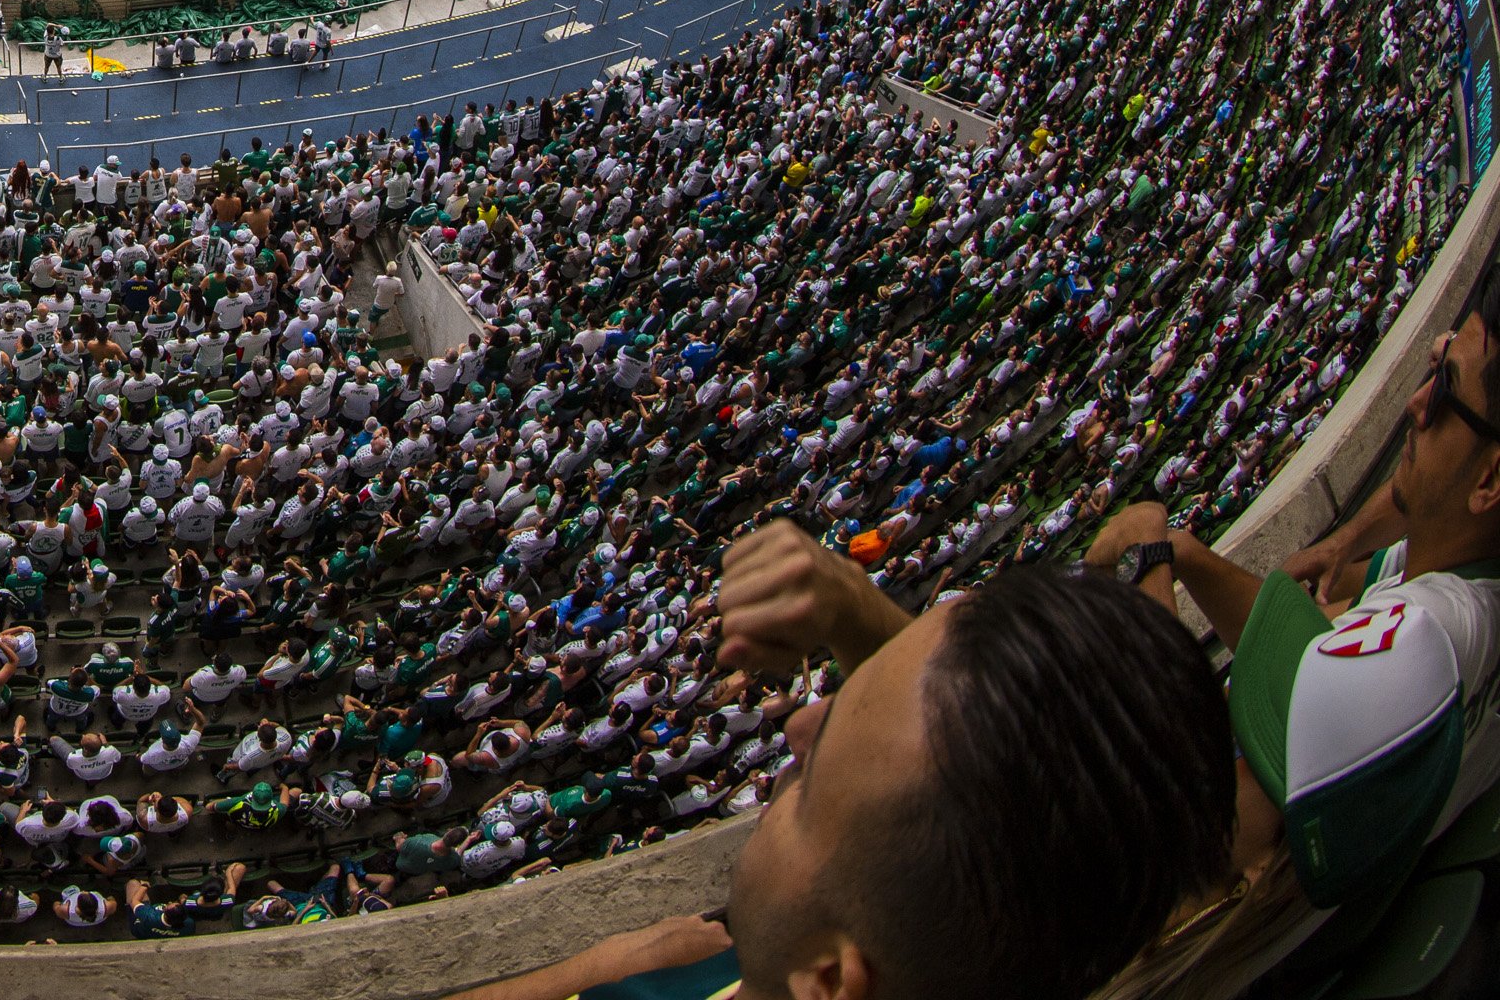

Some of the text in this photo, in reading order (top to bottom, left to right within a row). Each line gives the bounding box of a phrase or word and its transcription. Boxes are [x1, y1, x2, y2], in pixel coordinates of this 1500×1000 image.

[36, 331, 54, 343] 82
[99, 667, 124, 675] crefisa
[210, 679, 235, 688] crefisa
[80, 760, 106, 770] crefisa
